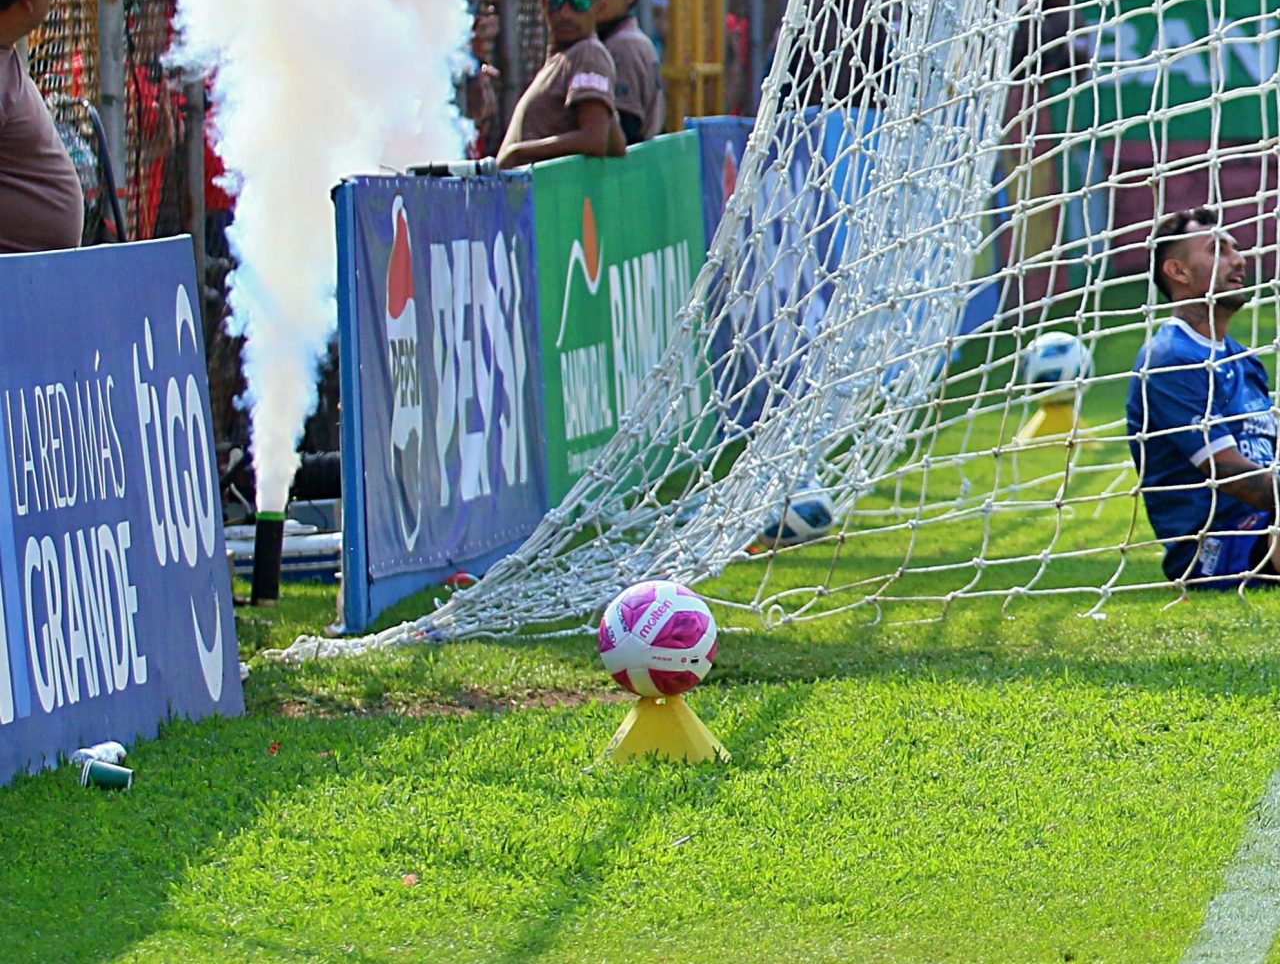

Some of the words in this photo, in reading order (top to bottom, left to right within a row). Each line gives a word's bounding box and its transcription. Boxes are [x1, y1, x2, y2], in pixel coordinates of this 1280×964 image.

[6, 388, 42, 515] LA
[34, 382, 78, 511] RED
[75, 349, 126, 504] MÁS
[430, 231, 527, 507] PEPSI
[25, 521, 147, 713] GRANDE
[639, 598, 674, 639] molten
